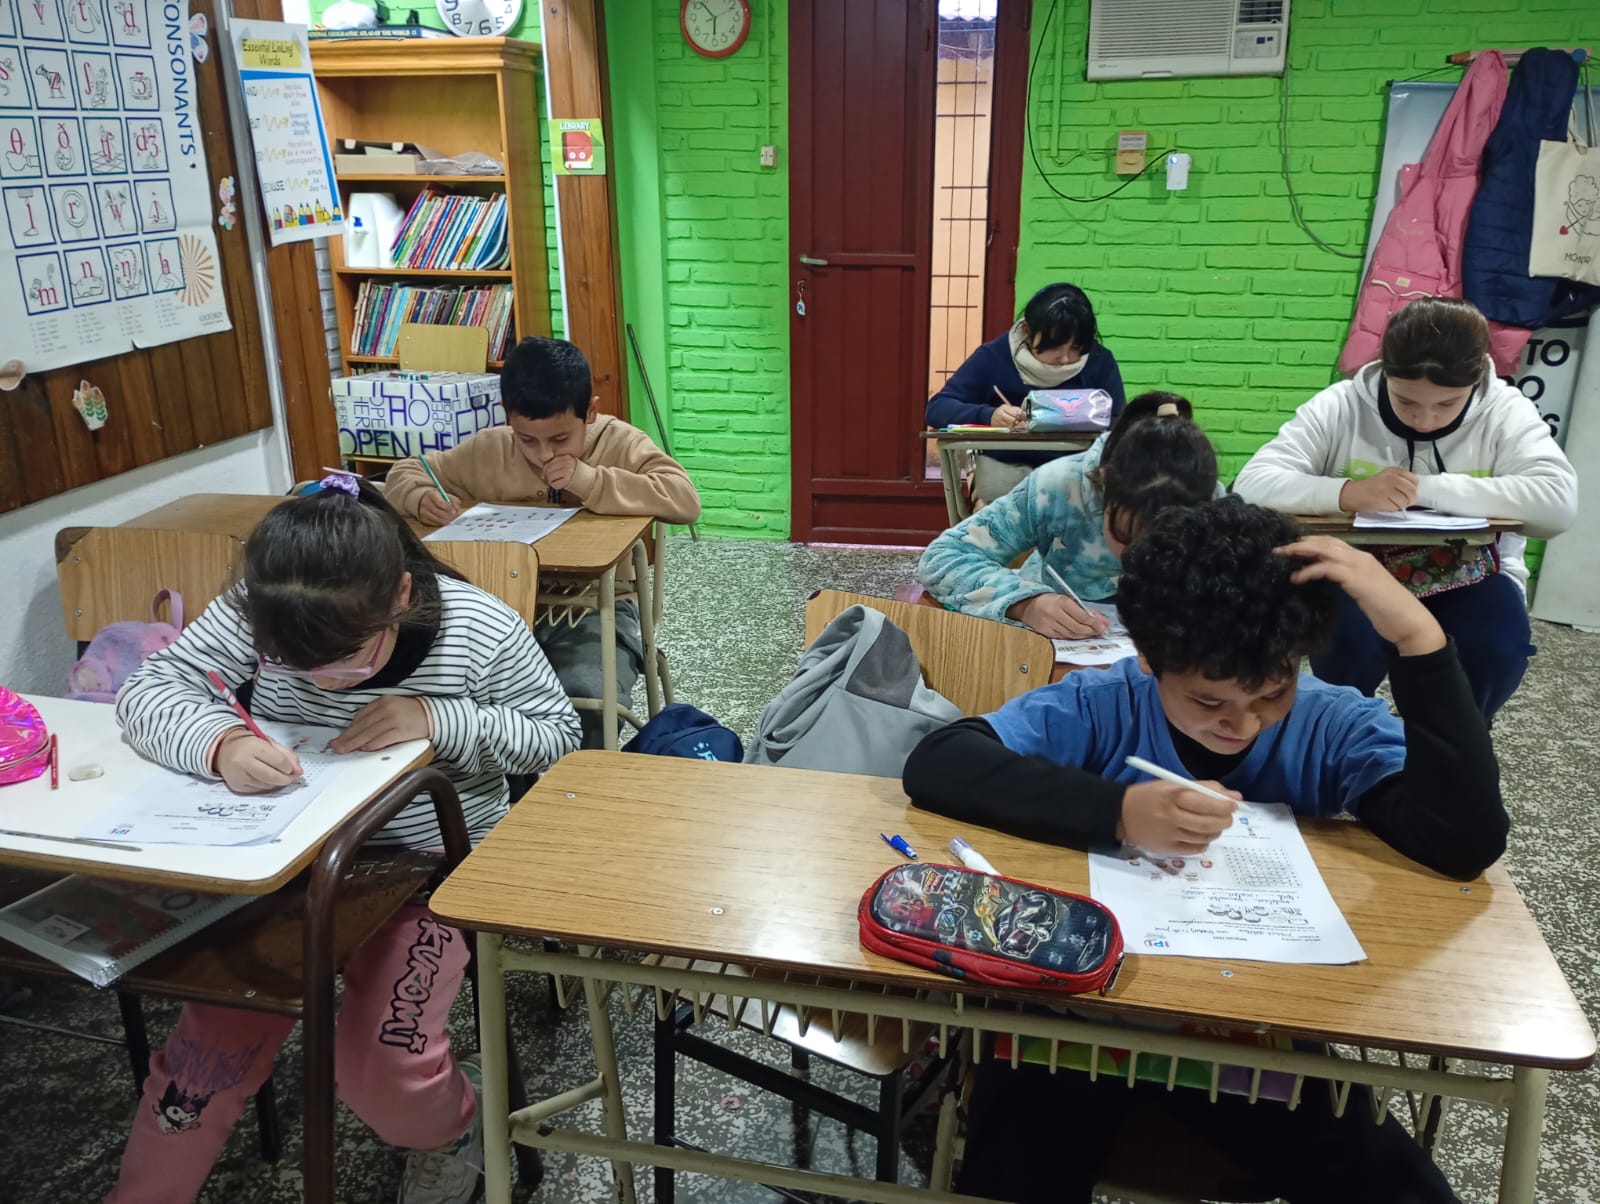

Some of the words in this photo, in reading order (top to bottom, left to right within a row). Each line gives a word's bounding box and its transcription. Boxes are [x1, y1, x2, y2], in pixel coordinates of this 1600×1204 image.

[452, 13, 462, 25] 8
[464, 21, 473, 34] 7
[479, 19, 492, 36] 6
[259, 53, 281, 66] Words
[163, 0, 196, 156] ONSONANTS
[80, 260, 95, 279] n
[38, 286, 59, 306] m
[1526, 339, 1571, 367] TO
